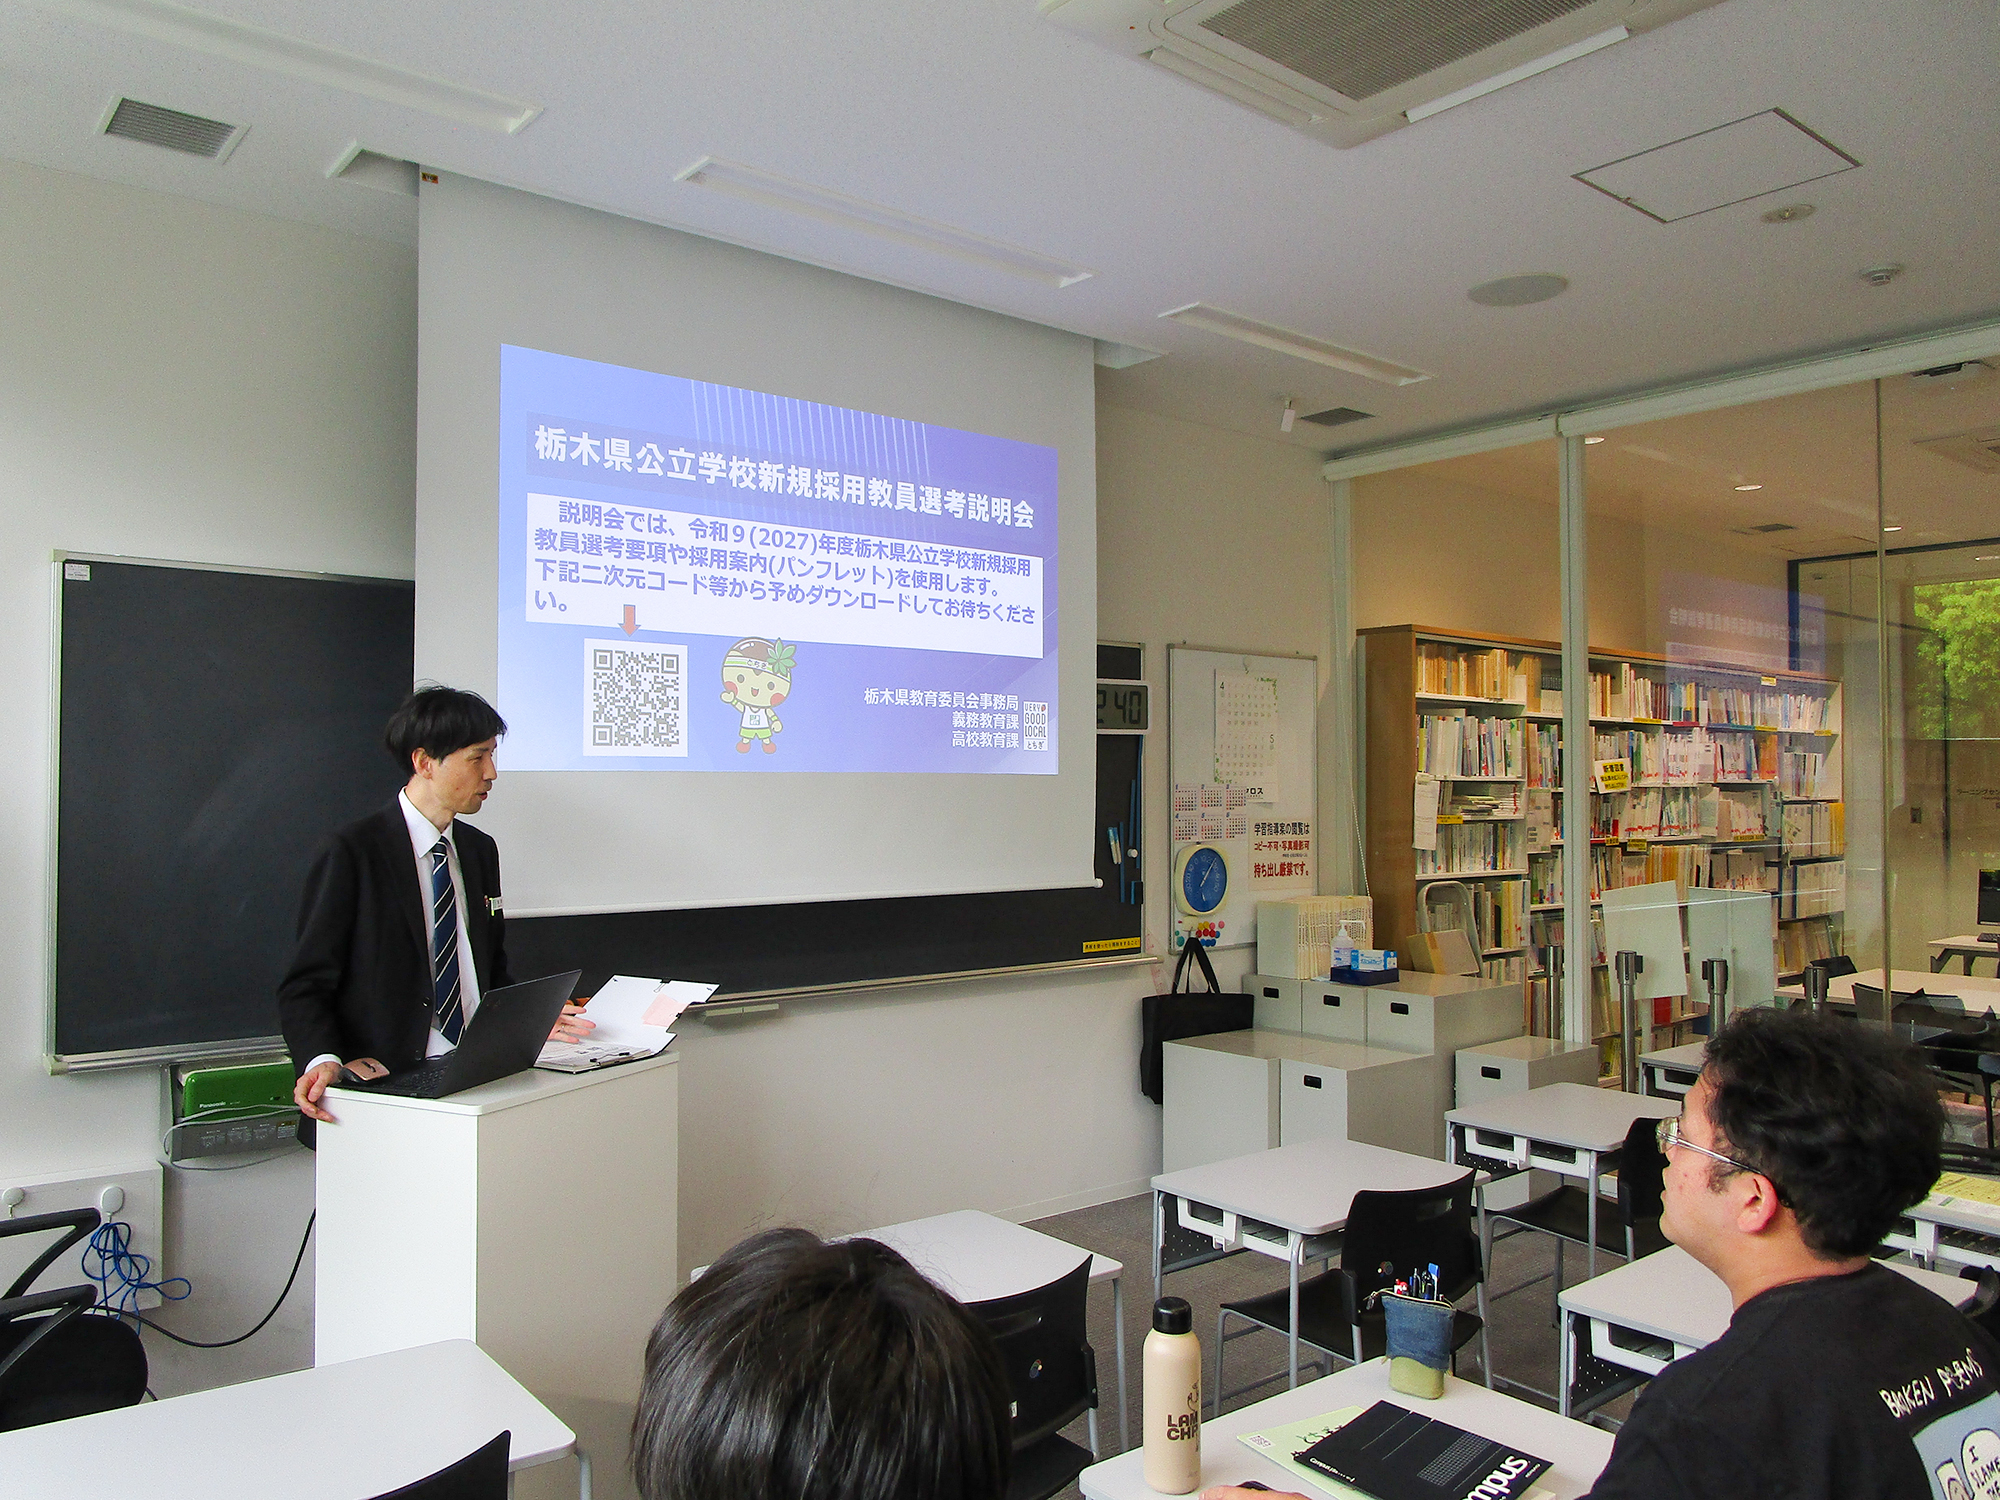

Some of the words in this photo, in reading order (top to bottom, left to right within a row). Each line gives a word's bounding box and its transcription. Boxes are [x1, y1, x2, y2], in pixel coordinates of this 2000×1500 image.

[534, 424, 1035, 529] 栃木県公立学校新規採用教員選考説明会
[534, 589, 568, 612] い。
[863, 687, 1019, 711] 栃木県教育委員会事務局
[1024, 703, 1041, 711] VERY
[952, 711, 1020, 730] 義務教育課
[1024, 712, 1046, 725] GOOD
[952, 730, 1020, 748] 高校教育課
[1024, 725, 1046, 738] LOCAL
[1027, 740, 1045, 750] とちぎ
[1878, 1375, 1936, 1418] BROKEN
